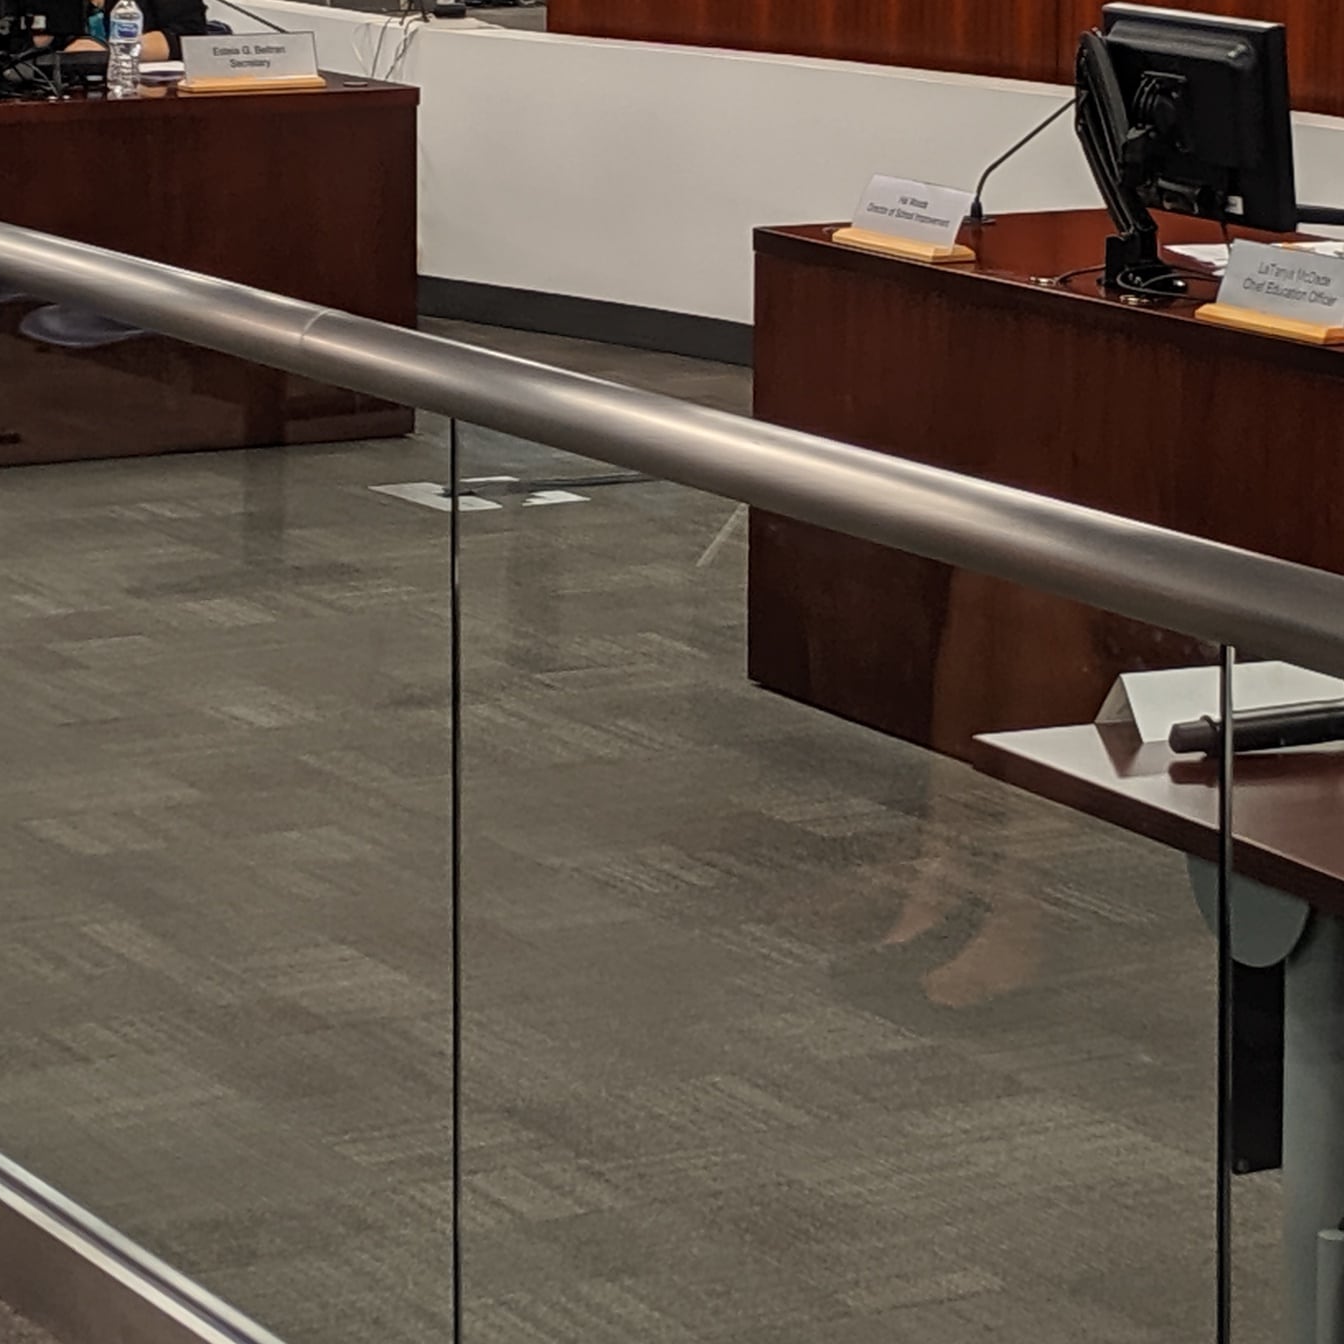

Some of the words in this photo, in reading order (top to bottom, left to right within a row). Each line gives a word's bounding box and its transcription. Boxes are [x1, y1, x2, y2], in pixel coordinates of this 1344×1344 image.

[230, 59, 270, 68] Secretary
[1243, 276, 1265, 292] Chief
[1265, 281, 1308, 301] Education
[1308, 290, 1337, 306] Officer
